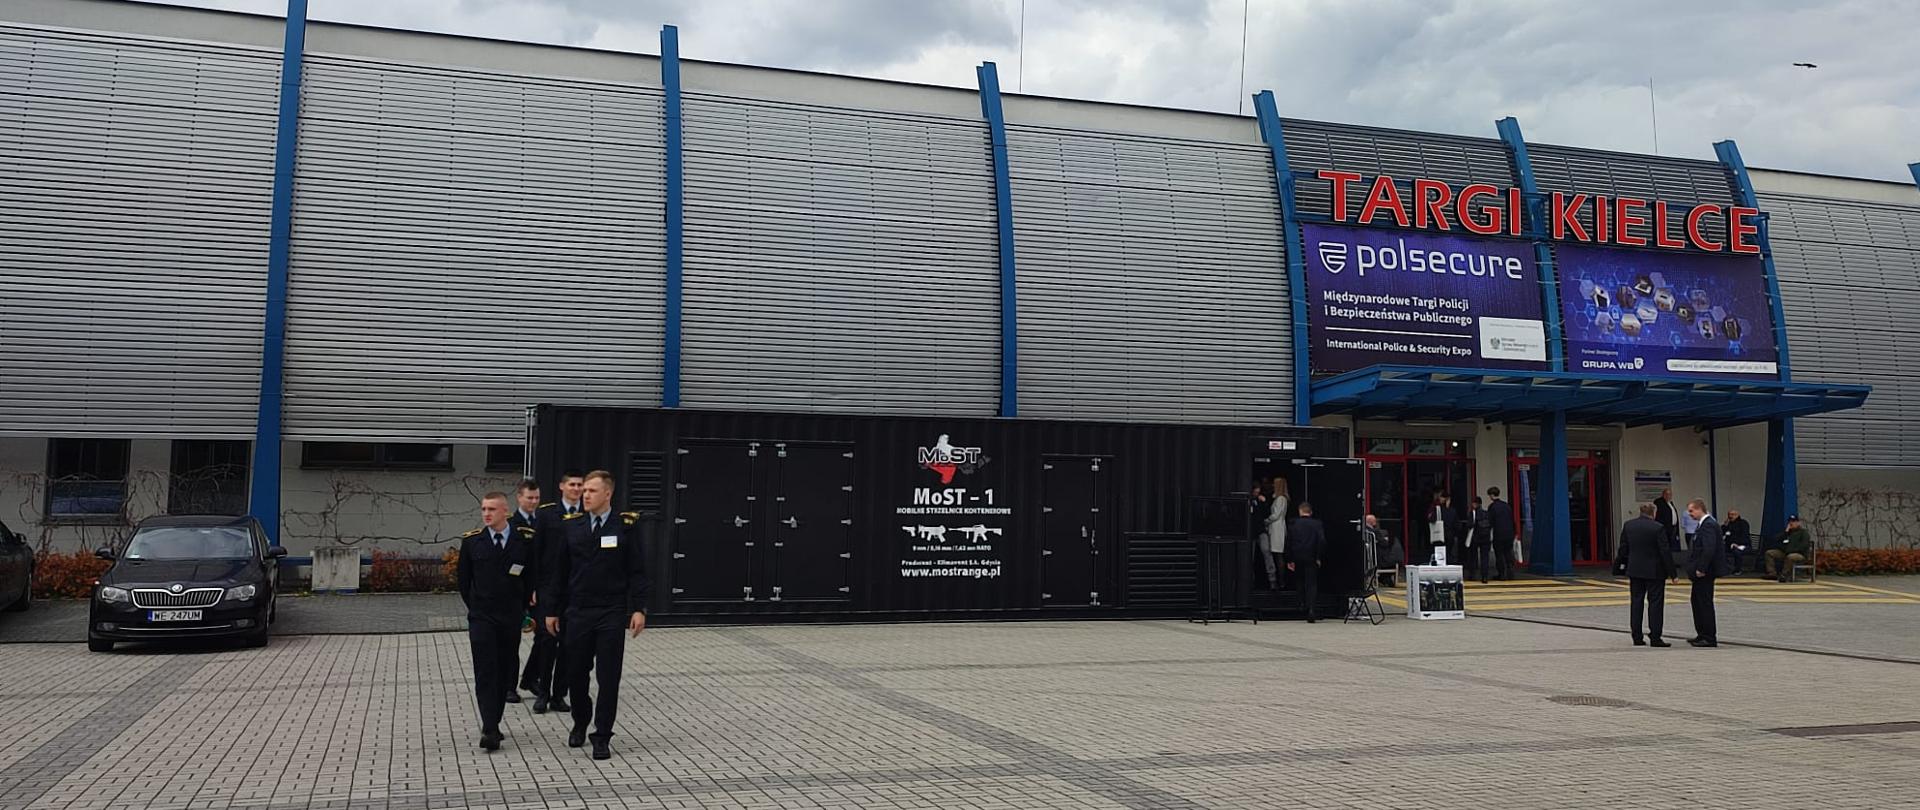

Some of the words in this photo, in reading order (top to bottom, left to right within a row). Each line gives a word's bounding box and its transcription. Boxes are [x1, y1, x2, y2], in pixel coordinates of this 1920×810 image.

[1318, 169, 1522, 236] TARGI
[1552, 191, 1761, 254] KIELCE
[1356, 238, 1523, 279] polsecure
[1323, 290, 1410, 306] Międzynarodowe
[1411, 296, 1437, 309] Targi
[1439, 298, 1469, 312] Policji
[1324, 305, 1328, 316] i
[1330, 306, 1411, 321] Bezpieczeństwa
[1413, 311, 1473, 326] Publicznego
[1326, 338, 1382, 351] International
[1383, 342, 1408, 353] Police
[1409, 343, 1416, 353] &
[1416, 343, 1451, 356] Security
[1452, 346, 1472, 356] Expo
[1582, 360, 1616, 369] GRUPA
[1617, 361, 1634, 370] WB
[913, 487, 967, 505] MoST
[984, 488, 994, 505] 1
[901, 565, 1001, 579] www.mostrange.pl
